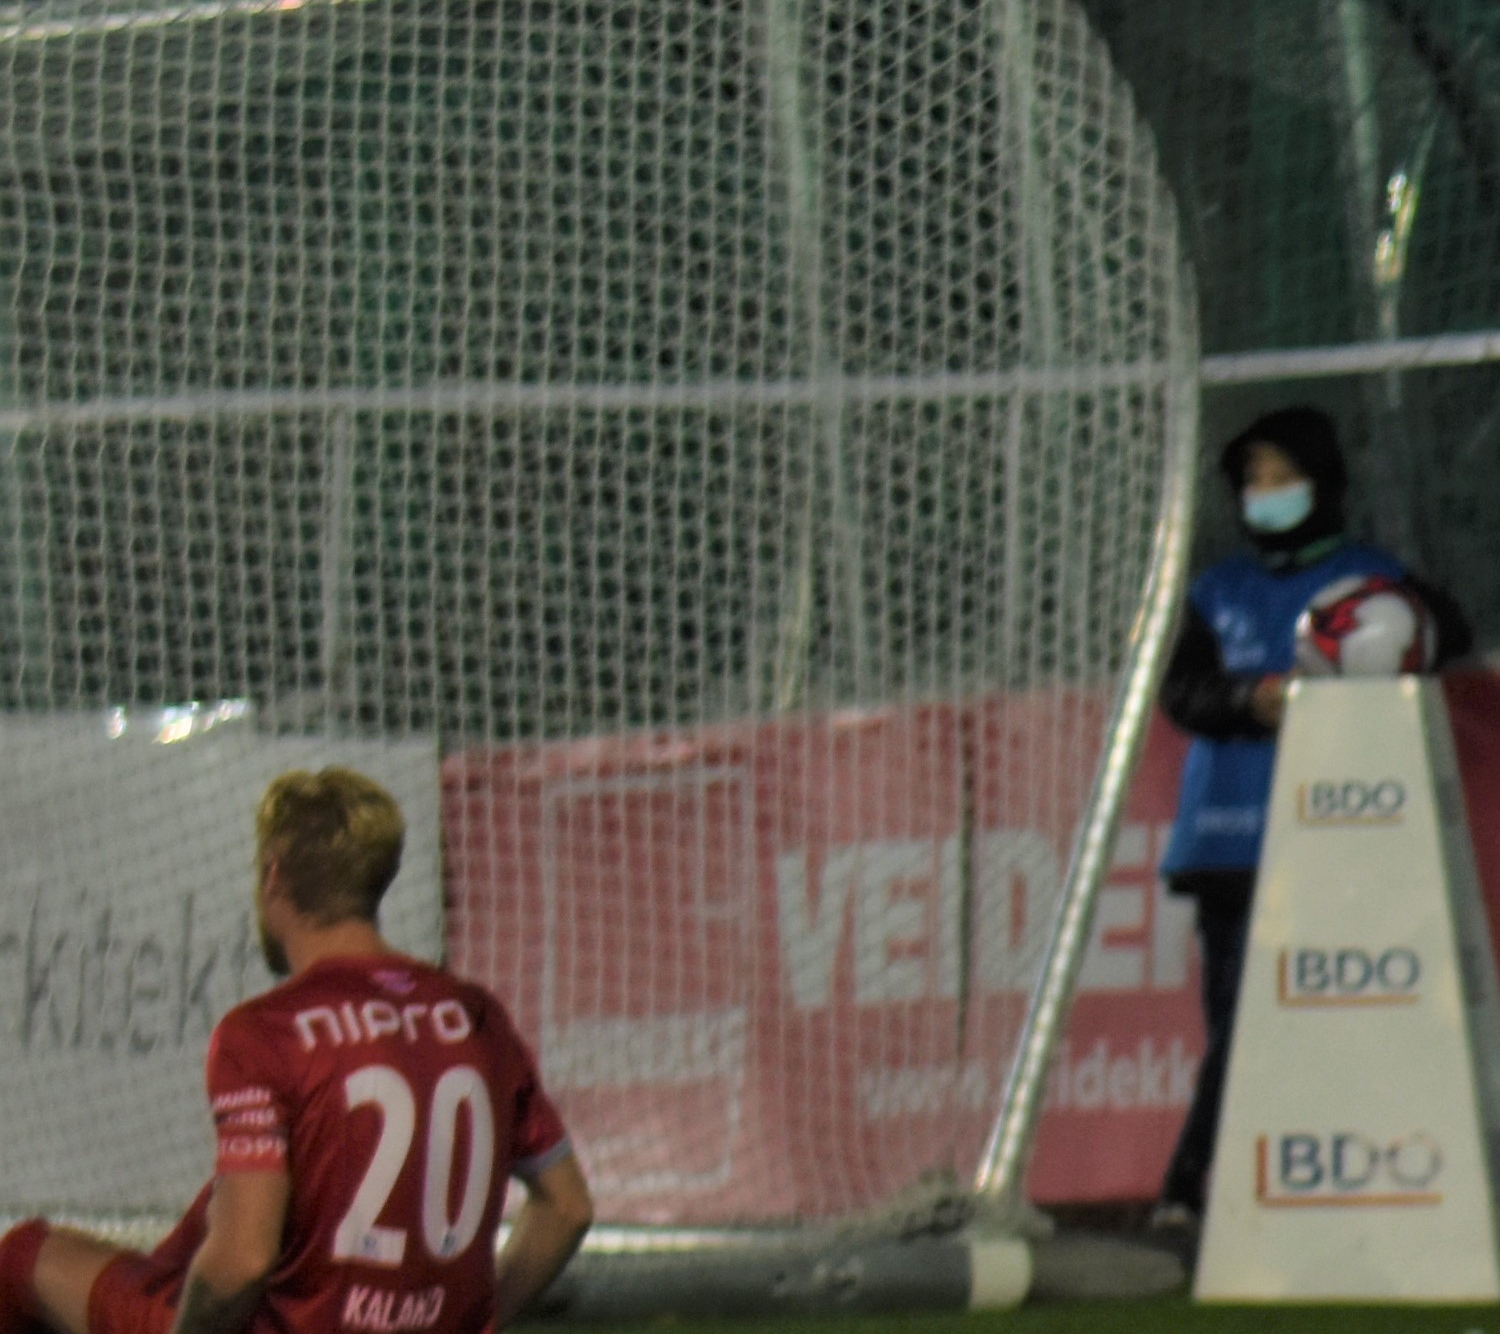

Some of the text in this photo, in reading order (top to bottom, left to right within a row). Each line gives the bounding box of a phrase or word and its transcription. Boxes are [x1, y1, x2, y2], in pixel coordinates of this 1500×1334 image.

[1310, 780, 1406, 818] BDO
[1296, 946, 1421, 995] BDO
[331, 1066, 496, 1264] 20
[1278, 1132, 1442, 1194] BDO
